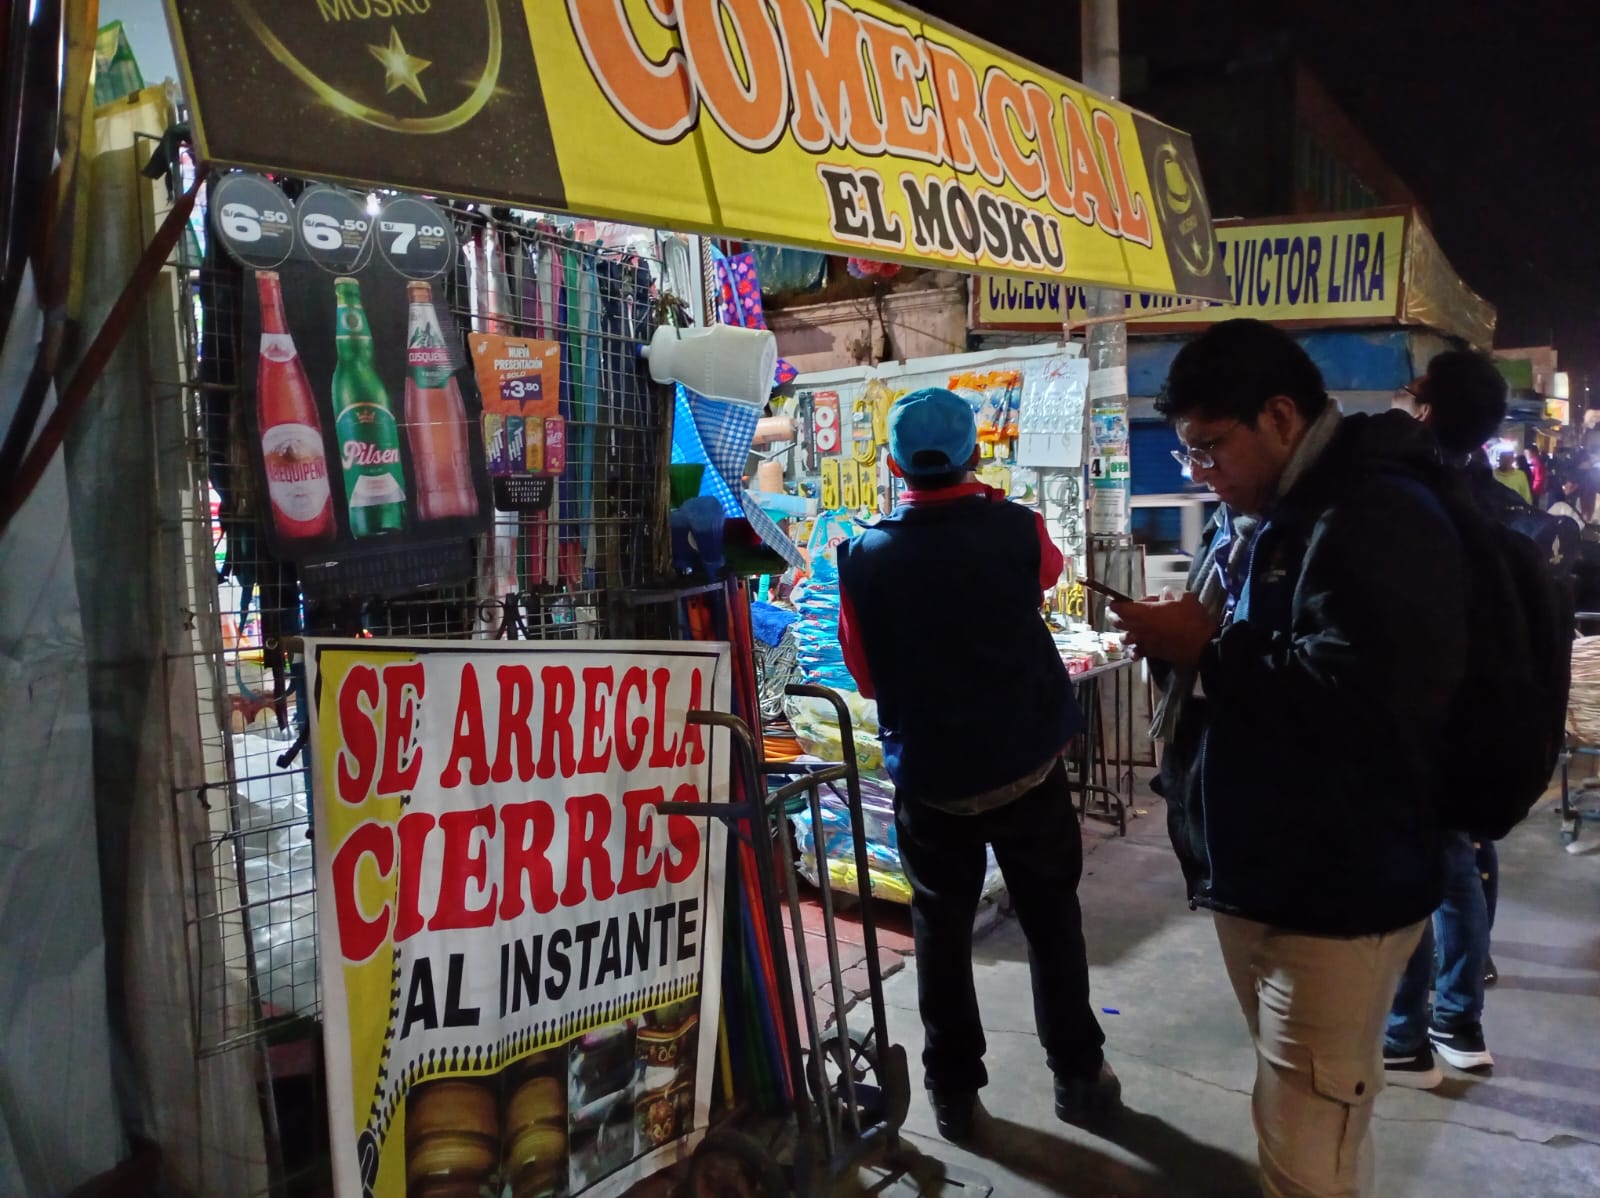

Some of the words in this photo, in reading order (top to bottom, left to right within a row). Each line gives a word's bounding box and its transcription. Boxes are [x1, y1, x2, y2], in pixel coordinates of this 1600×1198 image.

[570, 0, 1152, 249] COMERCIAL
[820, 168, 899, 244] EL
[903, 180, 1062, 268] MOSKU
[1327, 231, 1385, 303] LIRA
[342, 440, 399, 470] Pilsen
[338, 662, 425, 803] SE
[439, 662, 705, 789] ARREGLA
[332, 783, 701, 961] CIERRES
[401, 953, 480, 1040] AL
[500, 897, 698, 1019] INSTANTE
